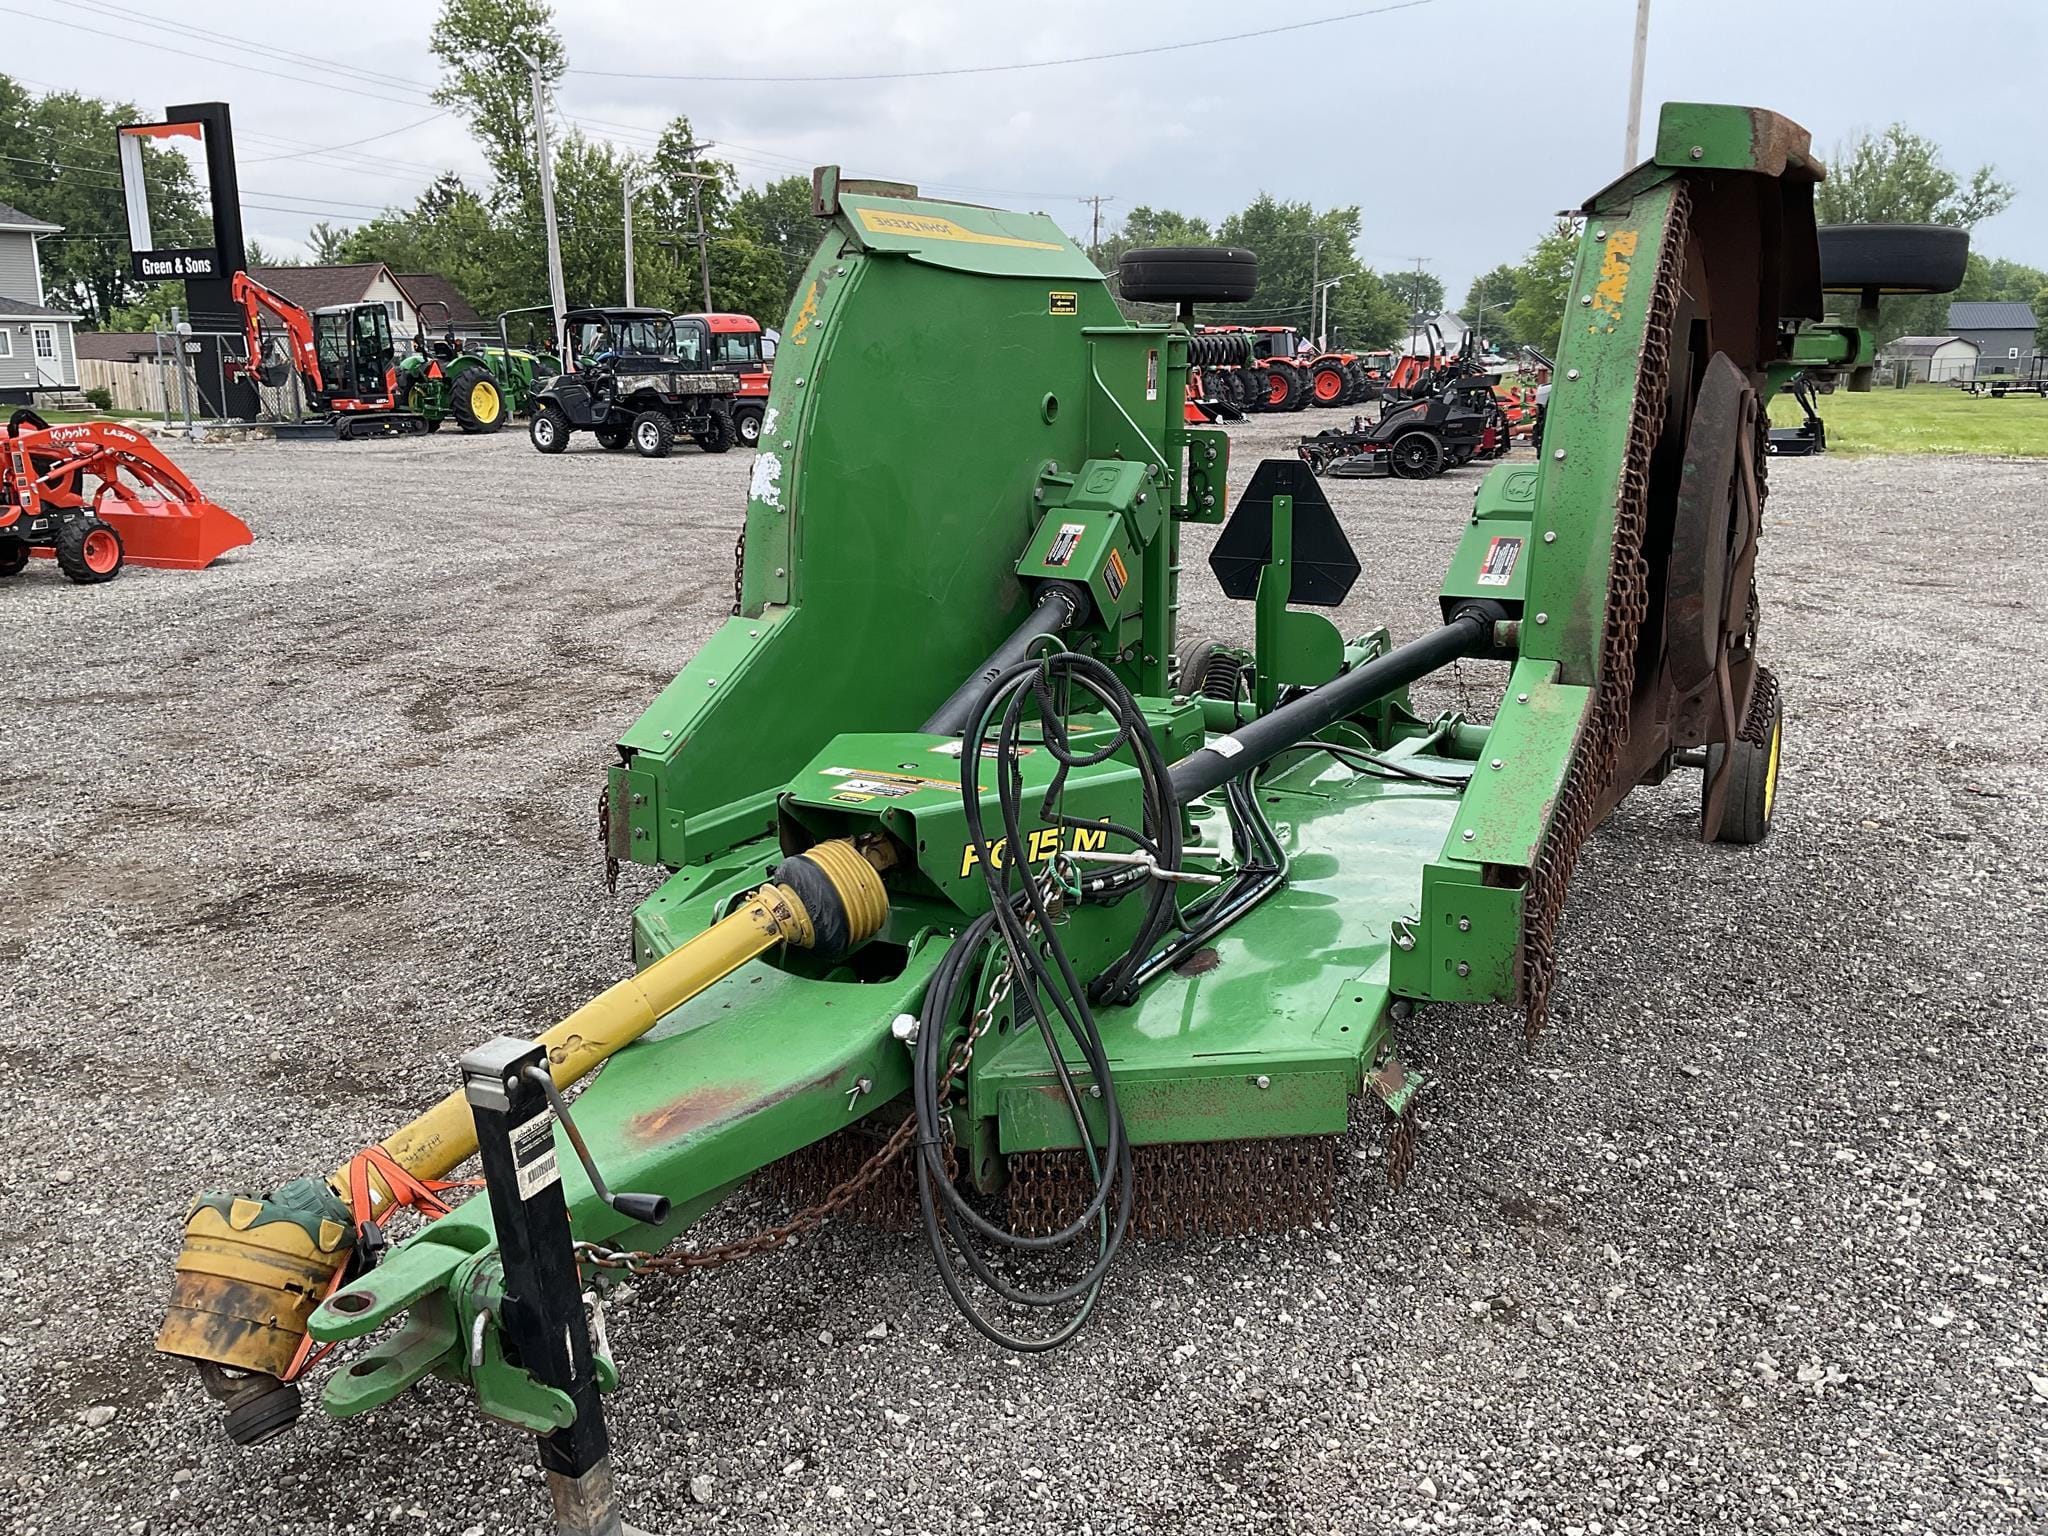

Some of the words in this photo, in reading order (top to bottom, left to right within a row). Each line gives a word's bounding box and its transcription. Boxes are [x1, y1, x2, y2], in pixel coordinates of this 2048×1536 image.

[142, 258, 173, 275] Green
[174, 257, 184, 274] &
[184, 256, 212, 273] Sons
[50, 426, 90, 441] Kubota
[103, 428, 138, 443] LA340
